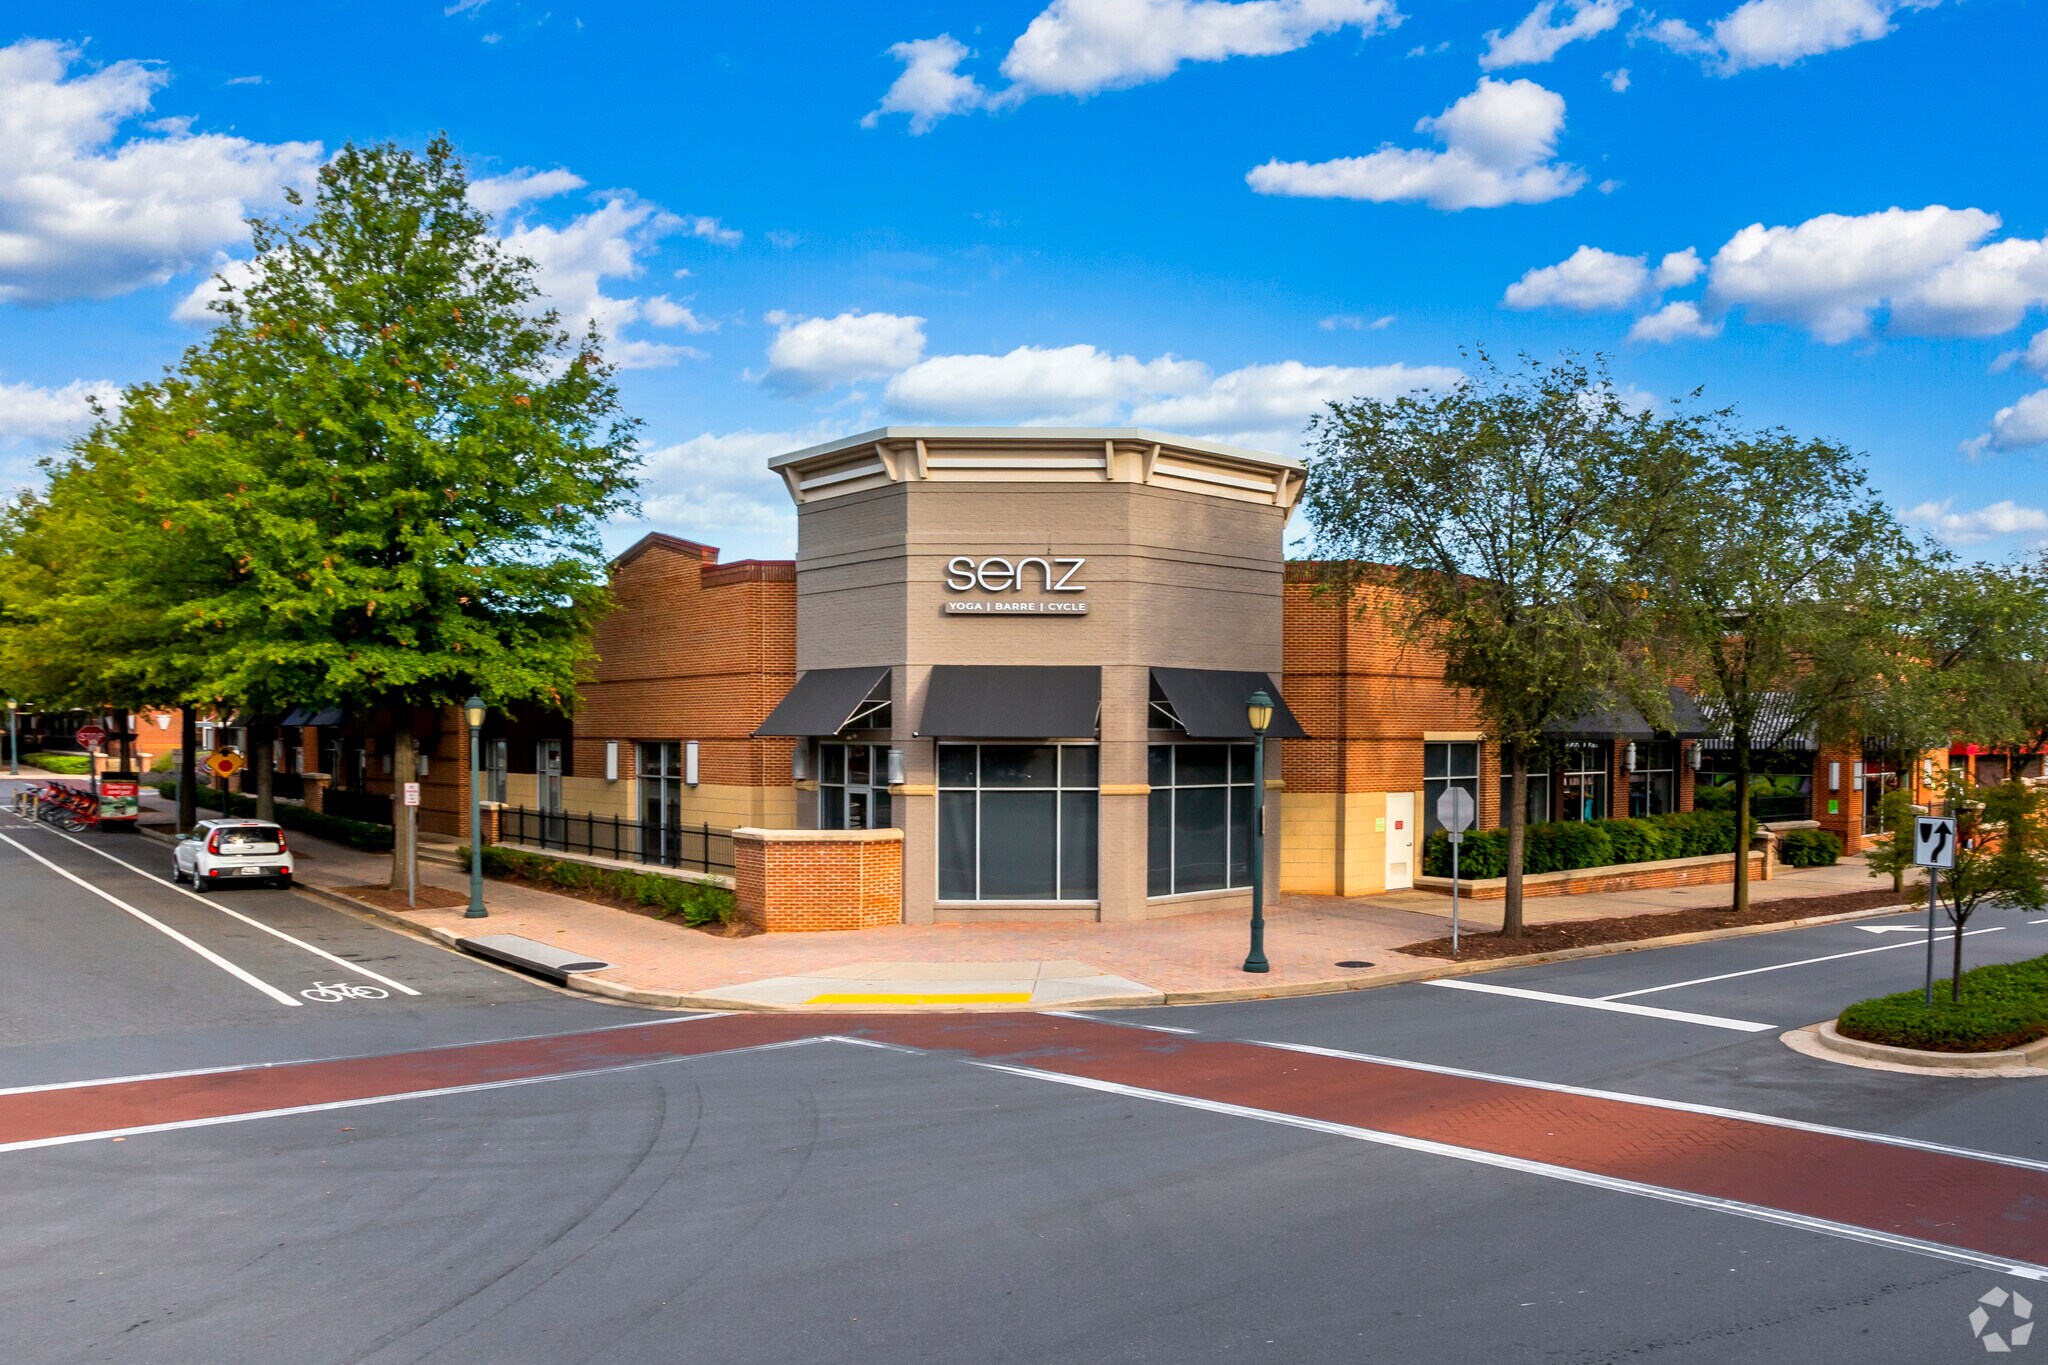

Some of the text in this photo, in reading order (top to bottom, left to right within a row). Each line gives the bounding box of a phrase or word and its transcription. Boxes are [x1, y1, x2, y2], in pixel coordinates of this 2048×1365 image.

[947, 556, 1087, 591] senz
[949, 602, 983, 611] YOGA
[995, 602, 1036, 611] BARRE
[1048, 602, 1086, 612] CYCLE
[79, 732, 105, 741] STOP
